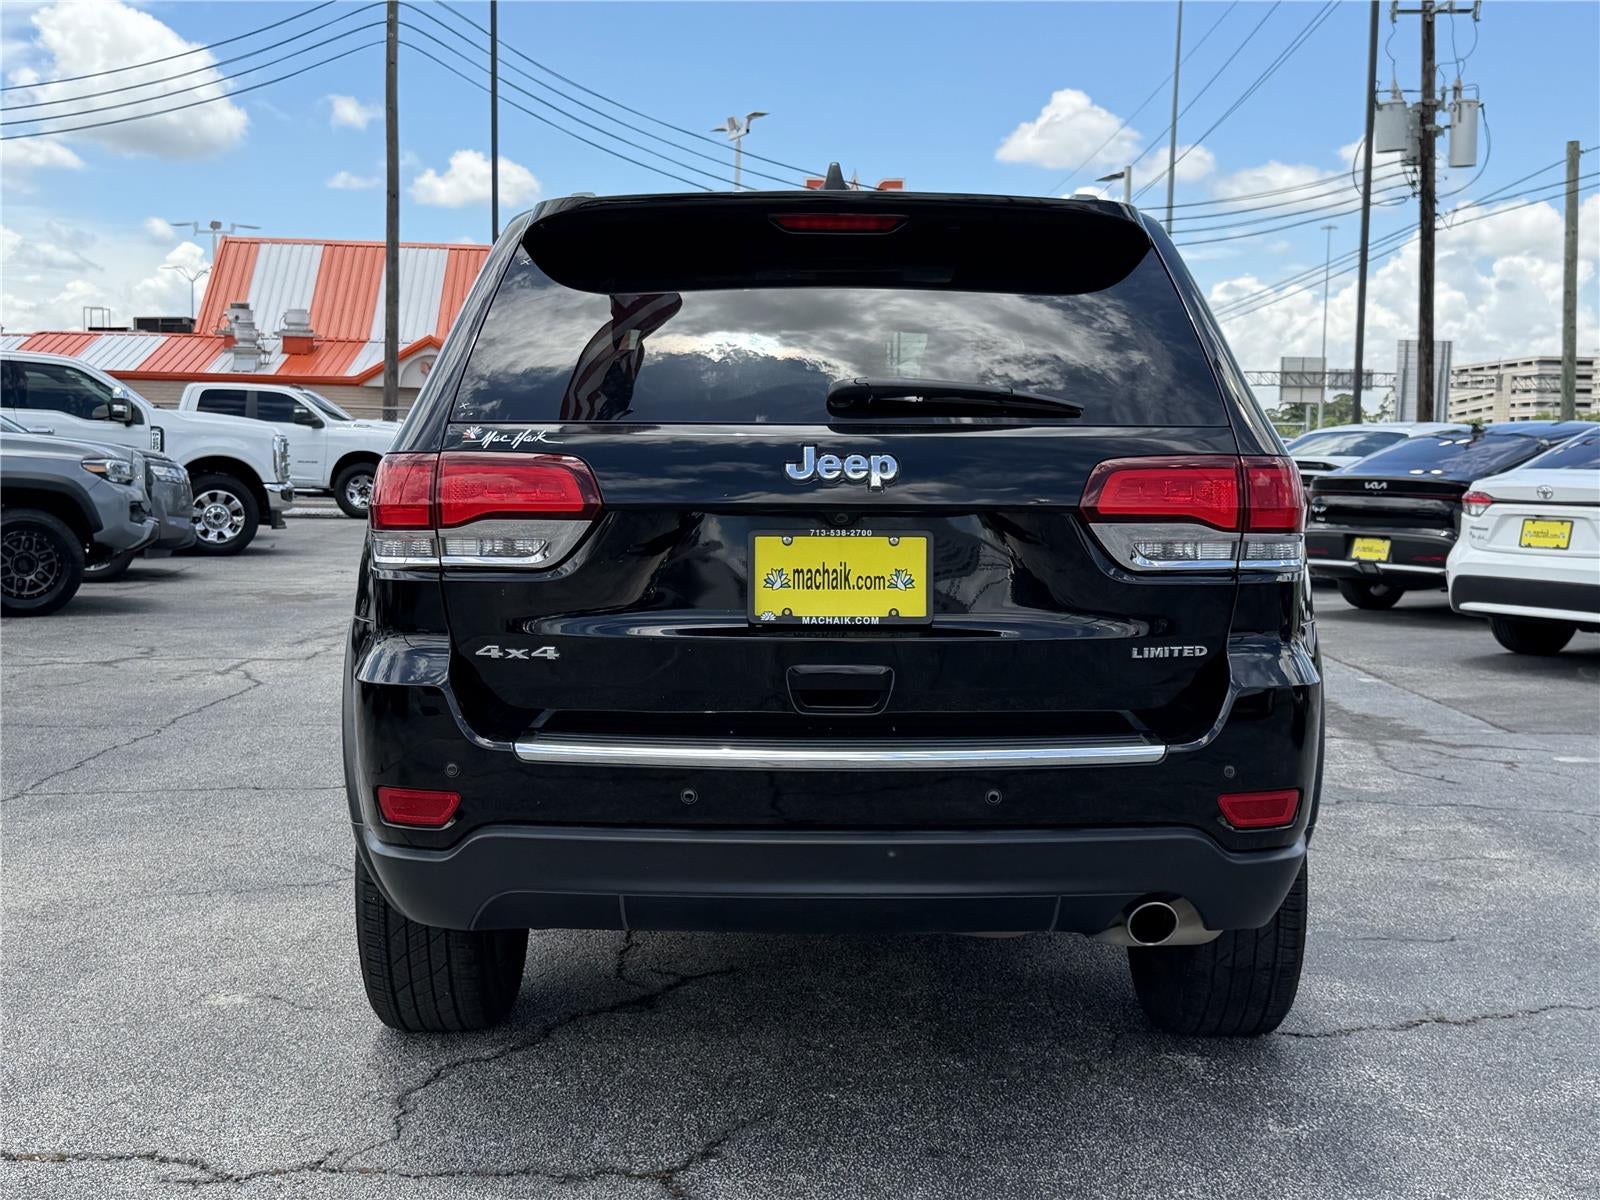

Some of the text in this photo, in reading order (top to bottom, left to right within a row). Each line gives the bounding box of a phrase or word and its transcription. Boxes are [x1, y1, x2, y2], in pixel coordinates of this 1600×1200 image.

[481, 429, 554, 449] Mac Haik
[785, 445, 898, 488] Jeep
[810, 529, 873, 537] 713-538-2700
[791, 561, 886, 591] machaik.com
[802, 616, 880, 625] MACHAIK.COM
[475, 644, 560, 660] 4x4
[1131, 645, 1208, 659] LIMITED
